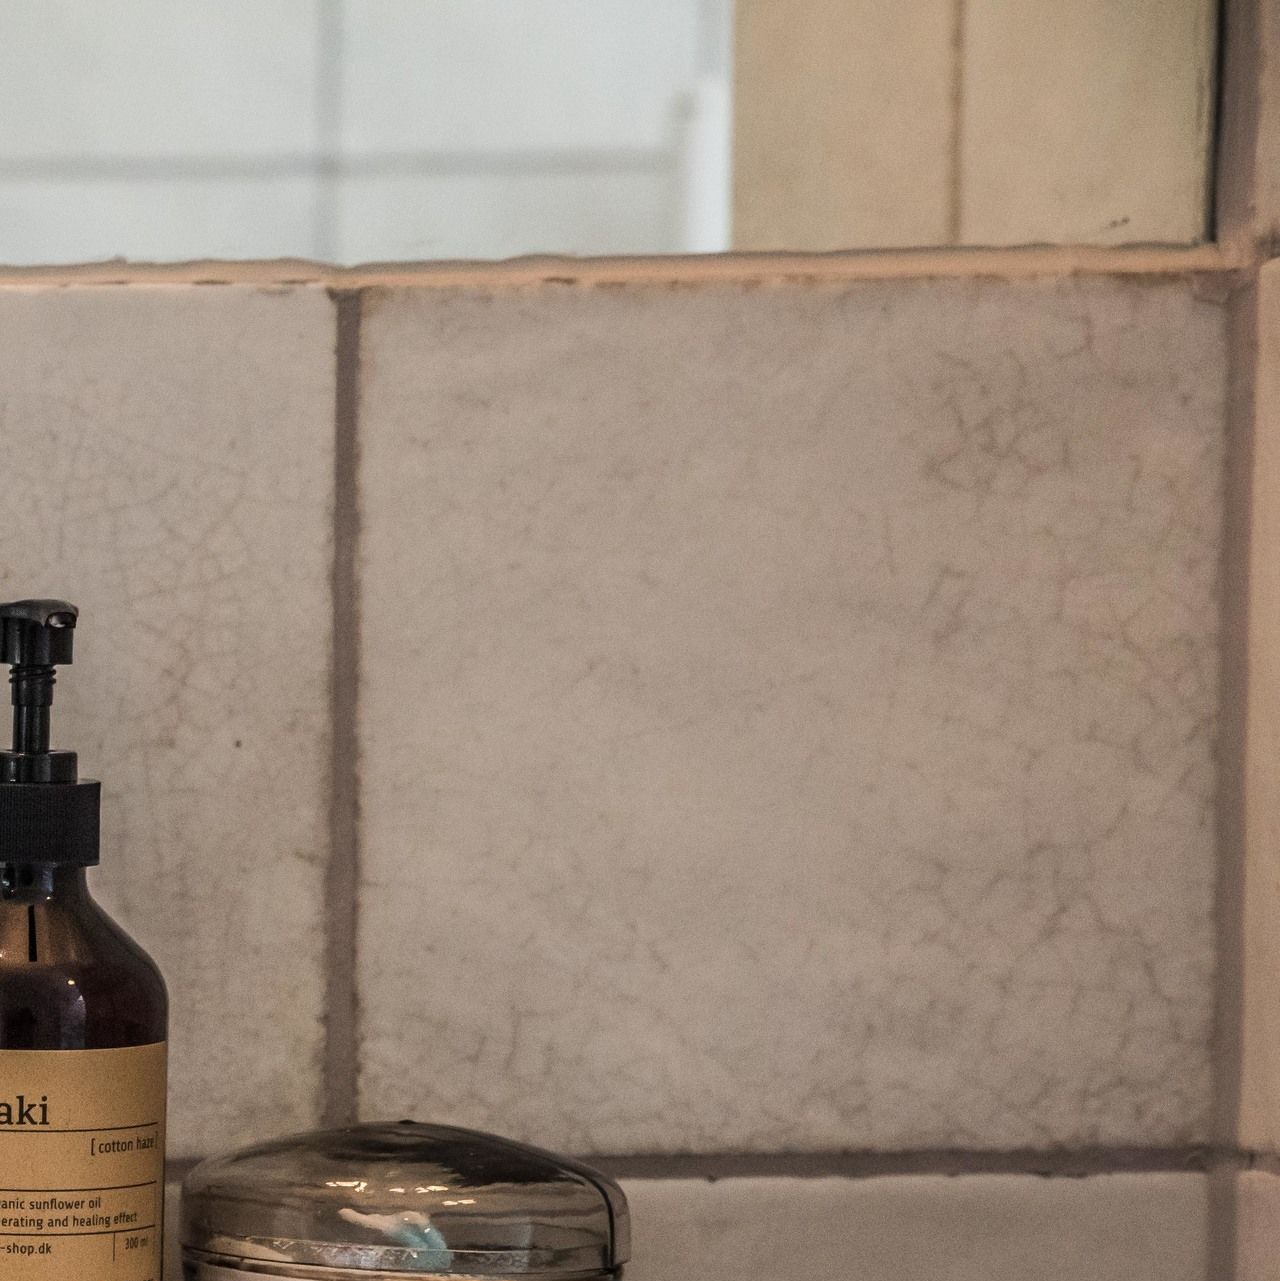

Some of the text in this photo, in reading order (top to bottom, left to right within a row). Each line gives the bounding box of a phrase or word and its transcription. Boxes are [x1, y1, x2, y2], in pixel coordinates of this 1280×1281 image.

[99, 1139, 134, 1154] cotton
[29, 1197, 85, 1210] sunflower
[88, 1197, 102, 1209] oil
[47, 1216, 69, 1228] and
[72, 1213, 111, 1229] healing
[113, 1211, 138, 1225] effect
[125, 1238, 139, 1250] 300
